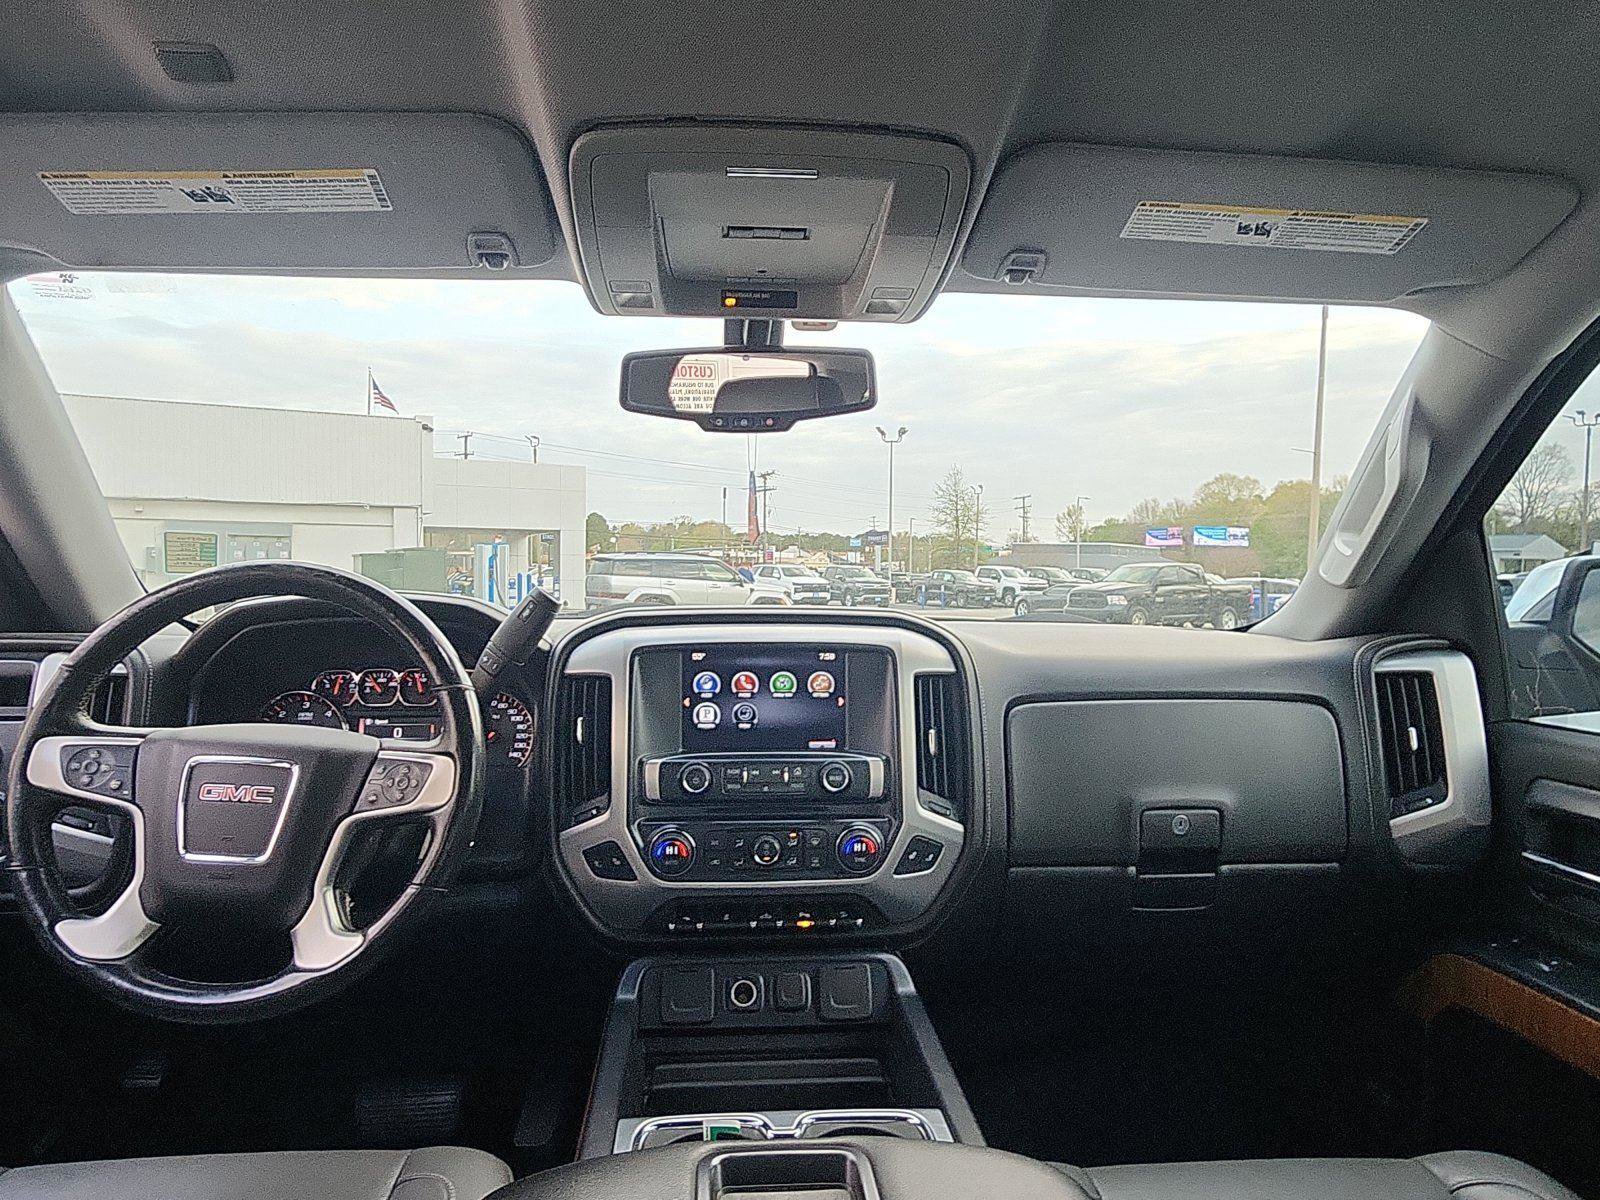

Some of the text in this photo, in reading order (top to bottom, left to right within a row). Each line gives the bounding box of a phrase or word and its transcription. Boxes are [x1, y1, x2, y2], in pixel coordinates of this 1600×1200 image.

[302, 701, 310, 709] 3
[324, 710, 333, 718] 4
[393, 726, 403, 739] 0
[199, 783, 275, 804] GMC
[665, 845, 679, 856] HI
[853, 842, 867, 853] HI
